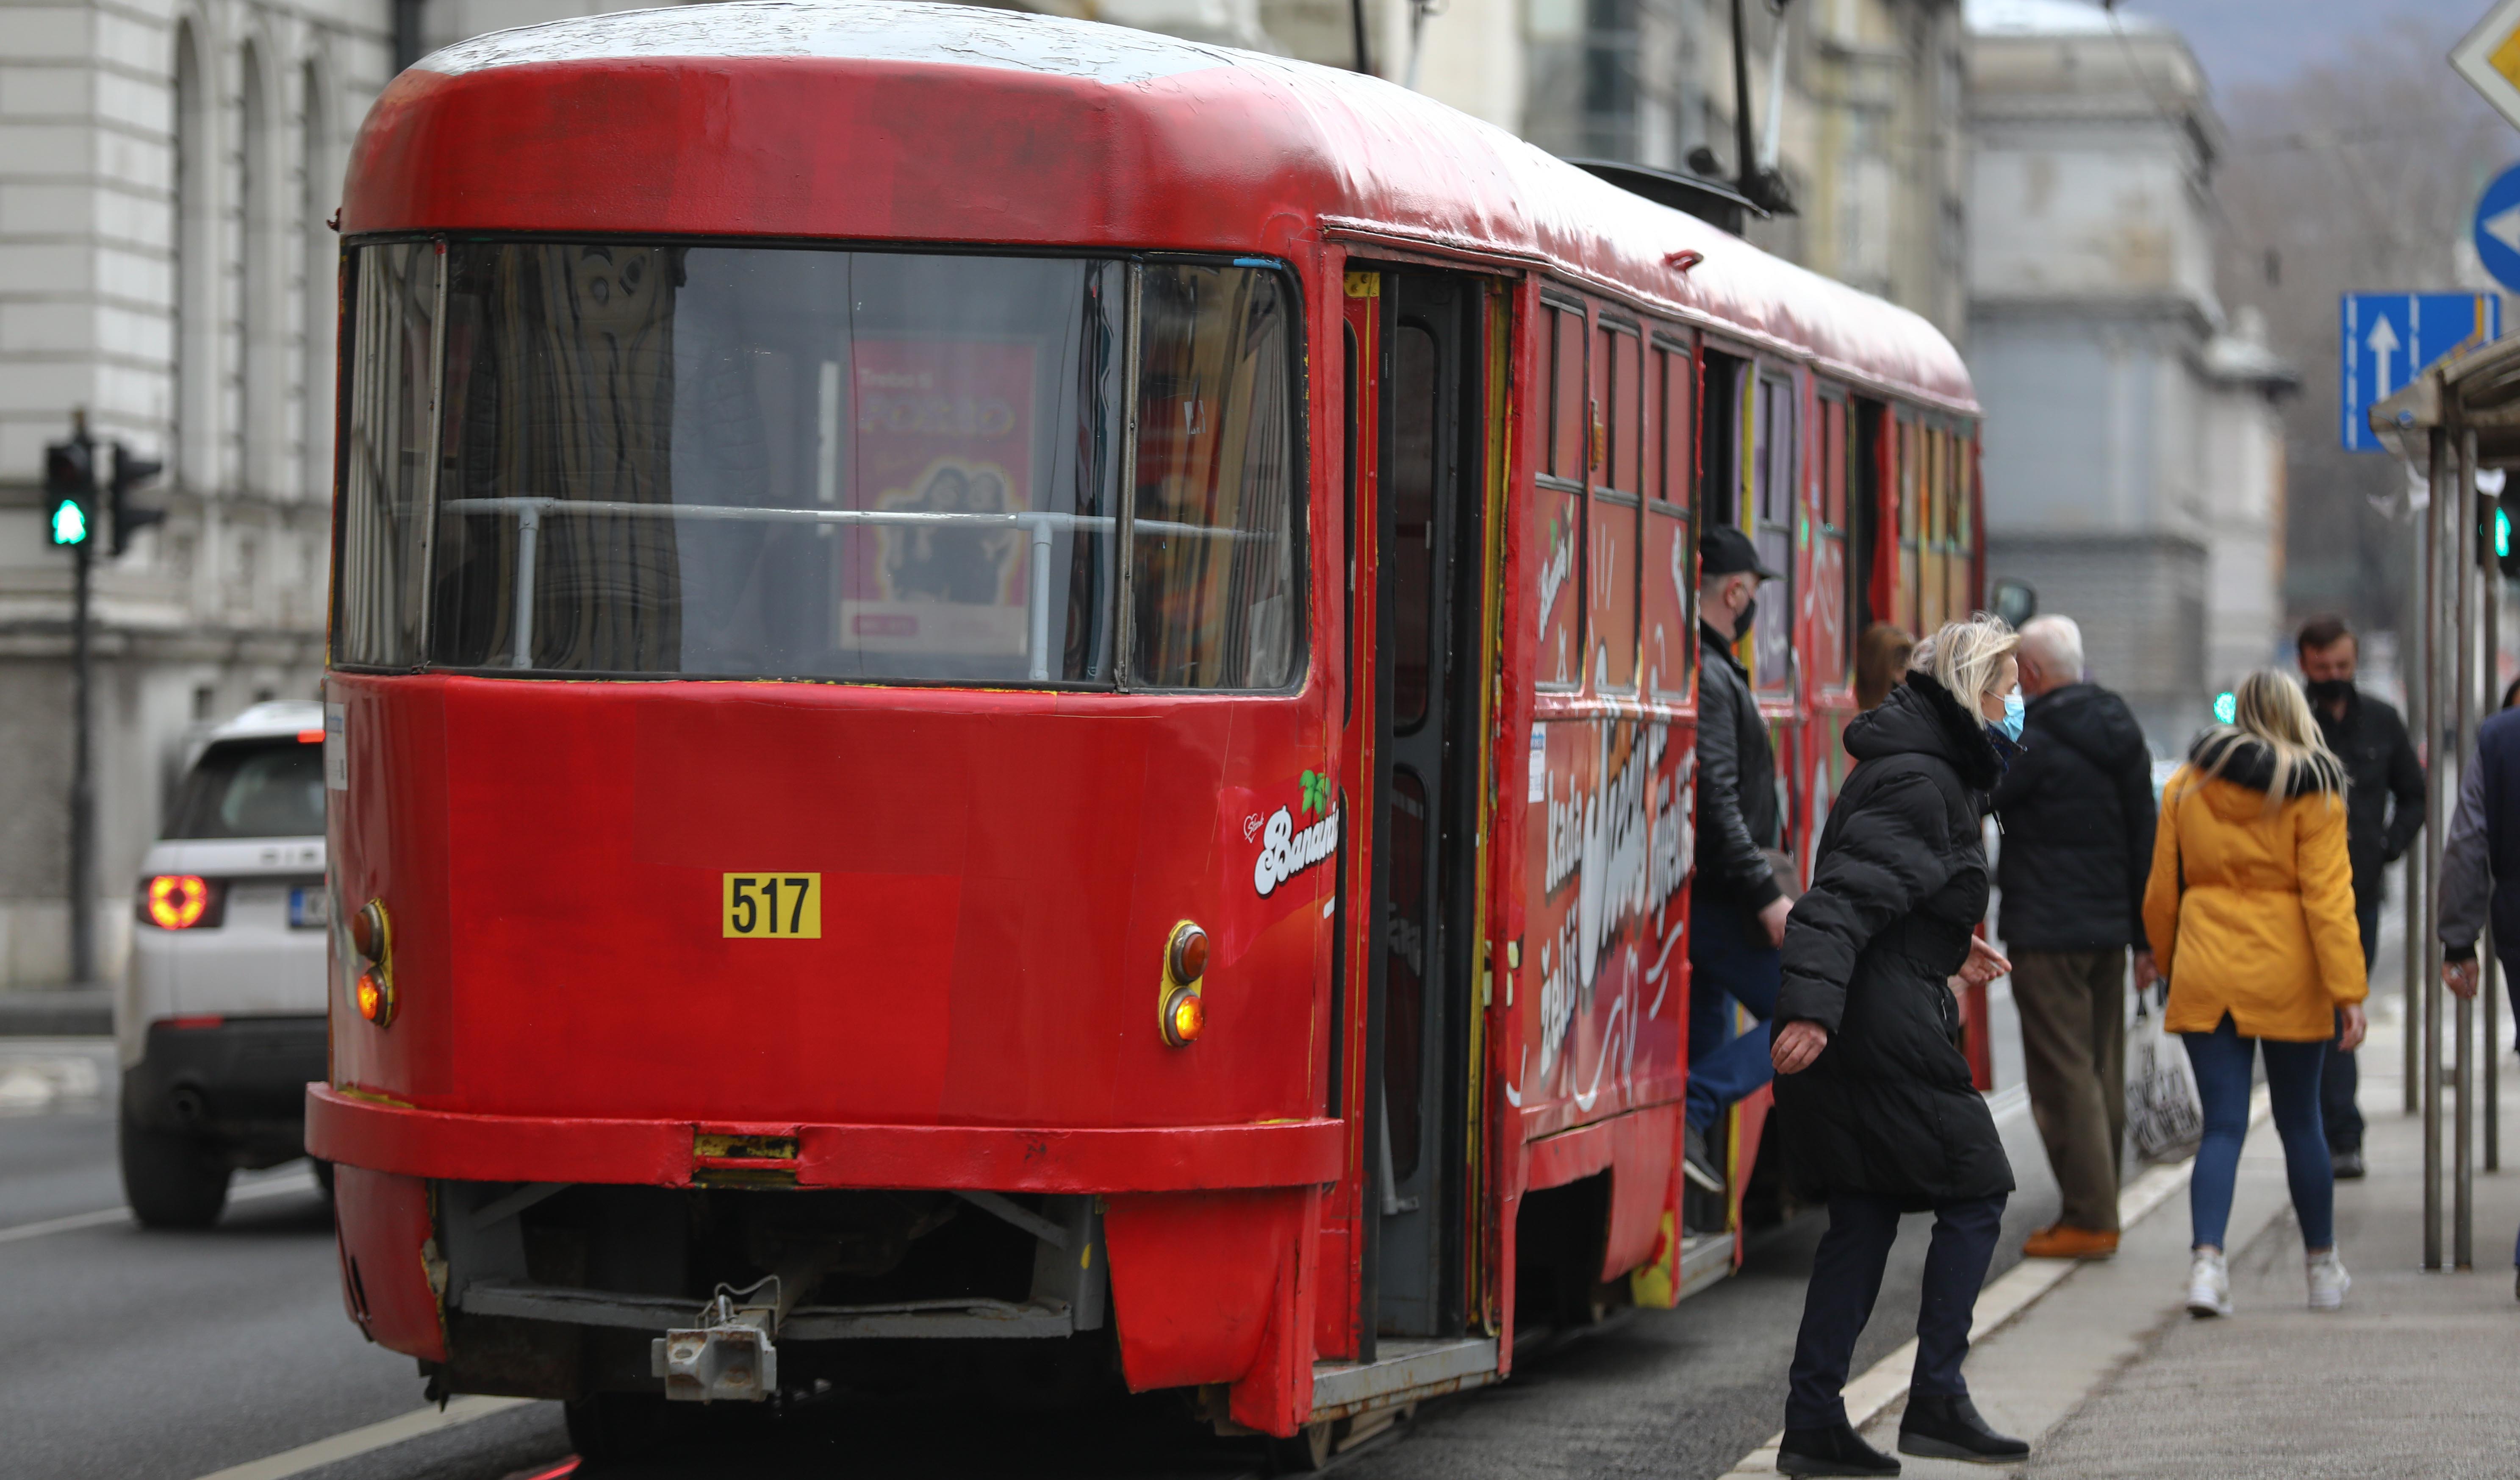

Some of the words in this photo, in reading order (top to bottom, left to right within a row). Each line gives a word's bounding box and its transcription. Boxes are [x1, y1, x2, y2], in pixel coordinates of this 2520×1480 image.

[1545, 769, 1582, 893] kada
[732, 878, 809, 933] 517
[1540, 897, 1577, 1077] želiš
